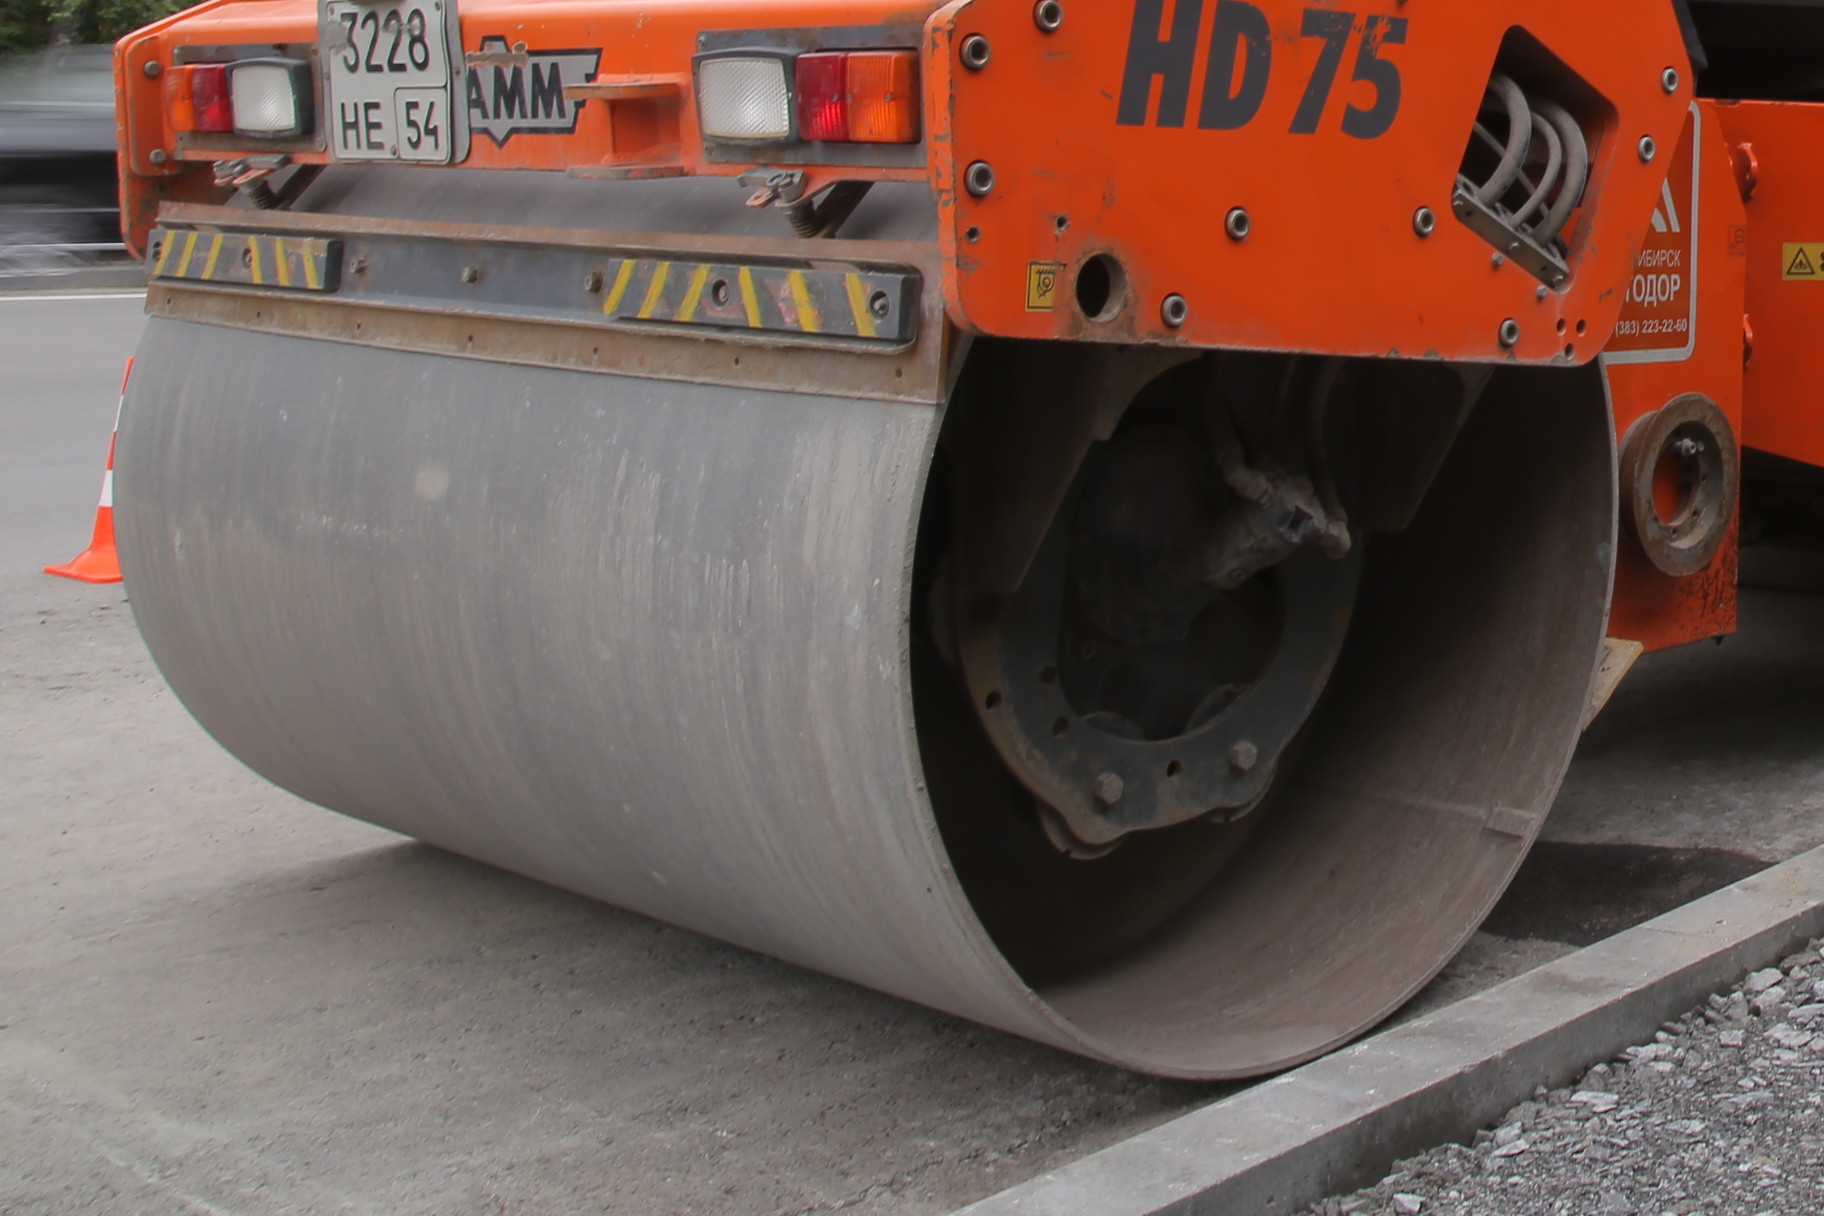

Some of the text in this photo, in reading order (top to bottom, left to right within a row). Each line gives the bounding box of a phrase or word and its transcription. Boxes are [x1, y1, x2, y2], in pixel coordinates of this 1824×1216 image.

[340, 8, 430, 73] 3228
[1287, 7, 1408, 140] 75
[404, 100, 439, 150] 54
[1641, 318, 1688, 334] 223-22-60
